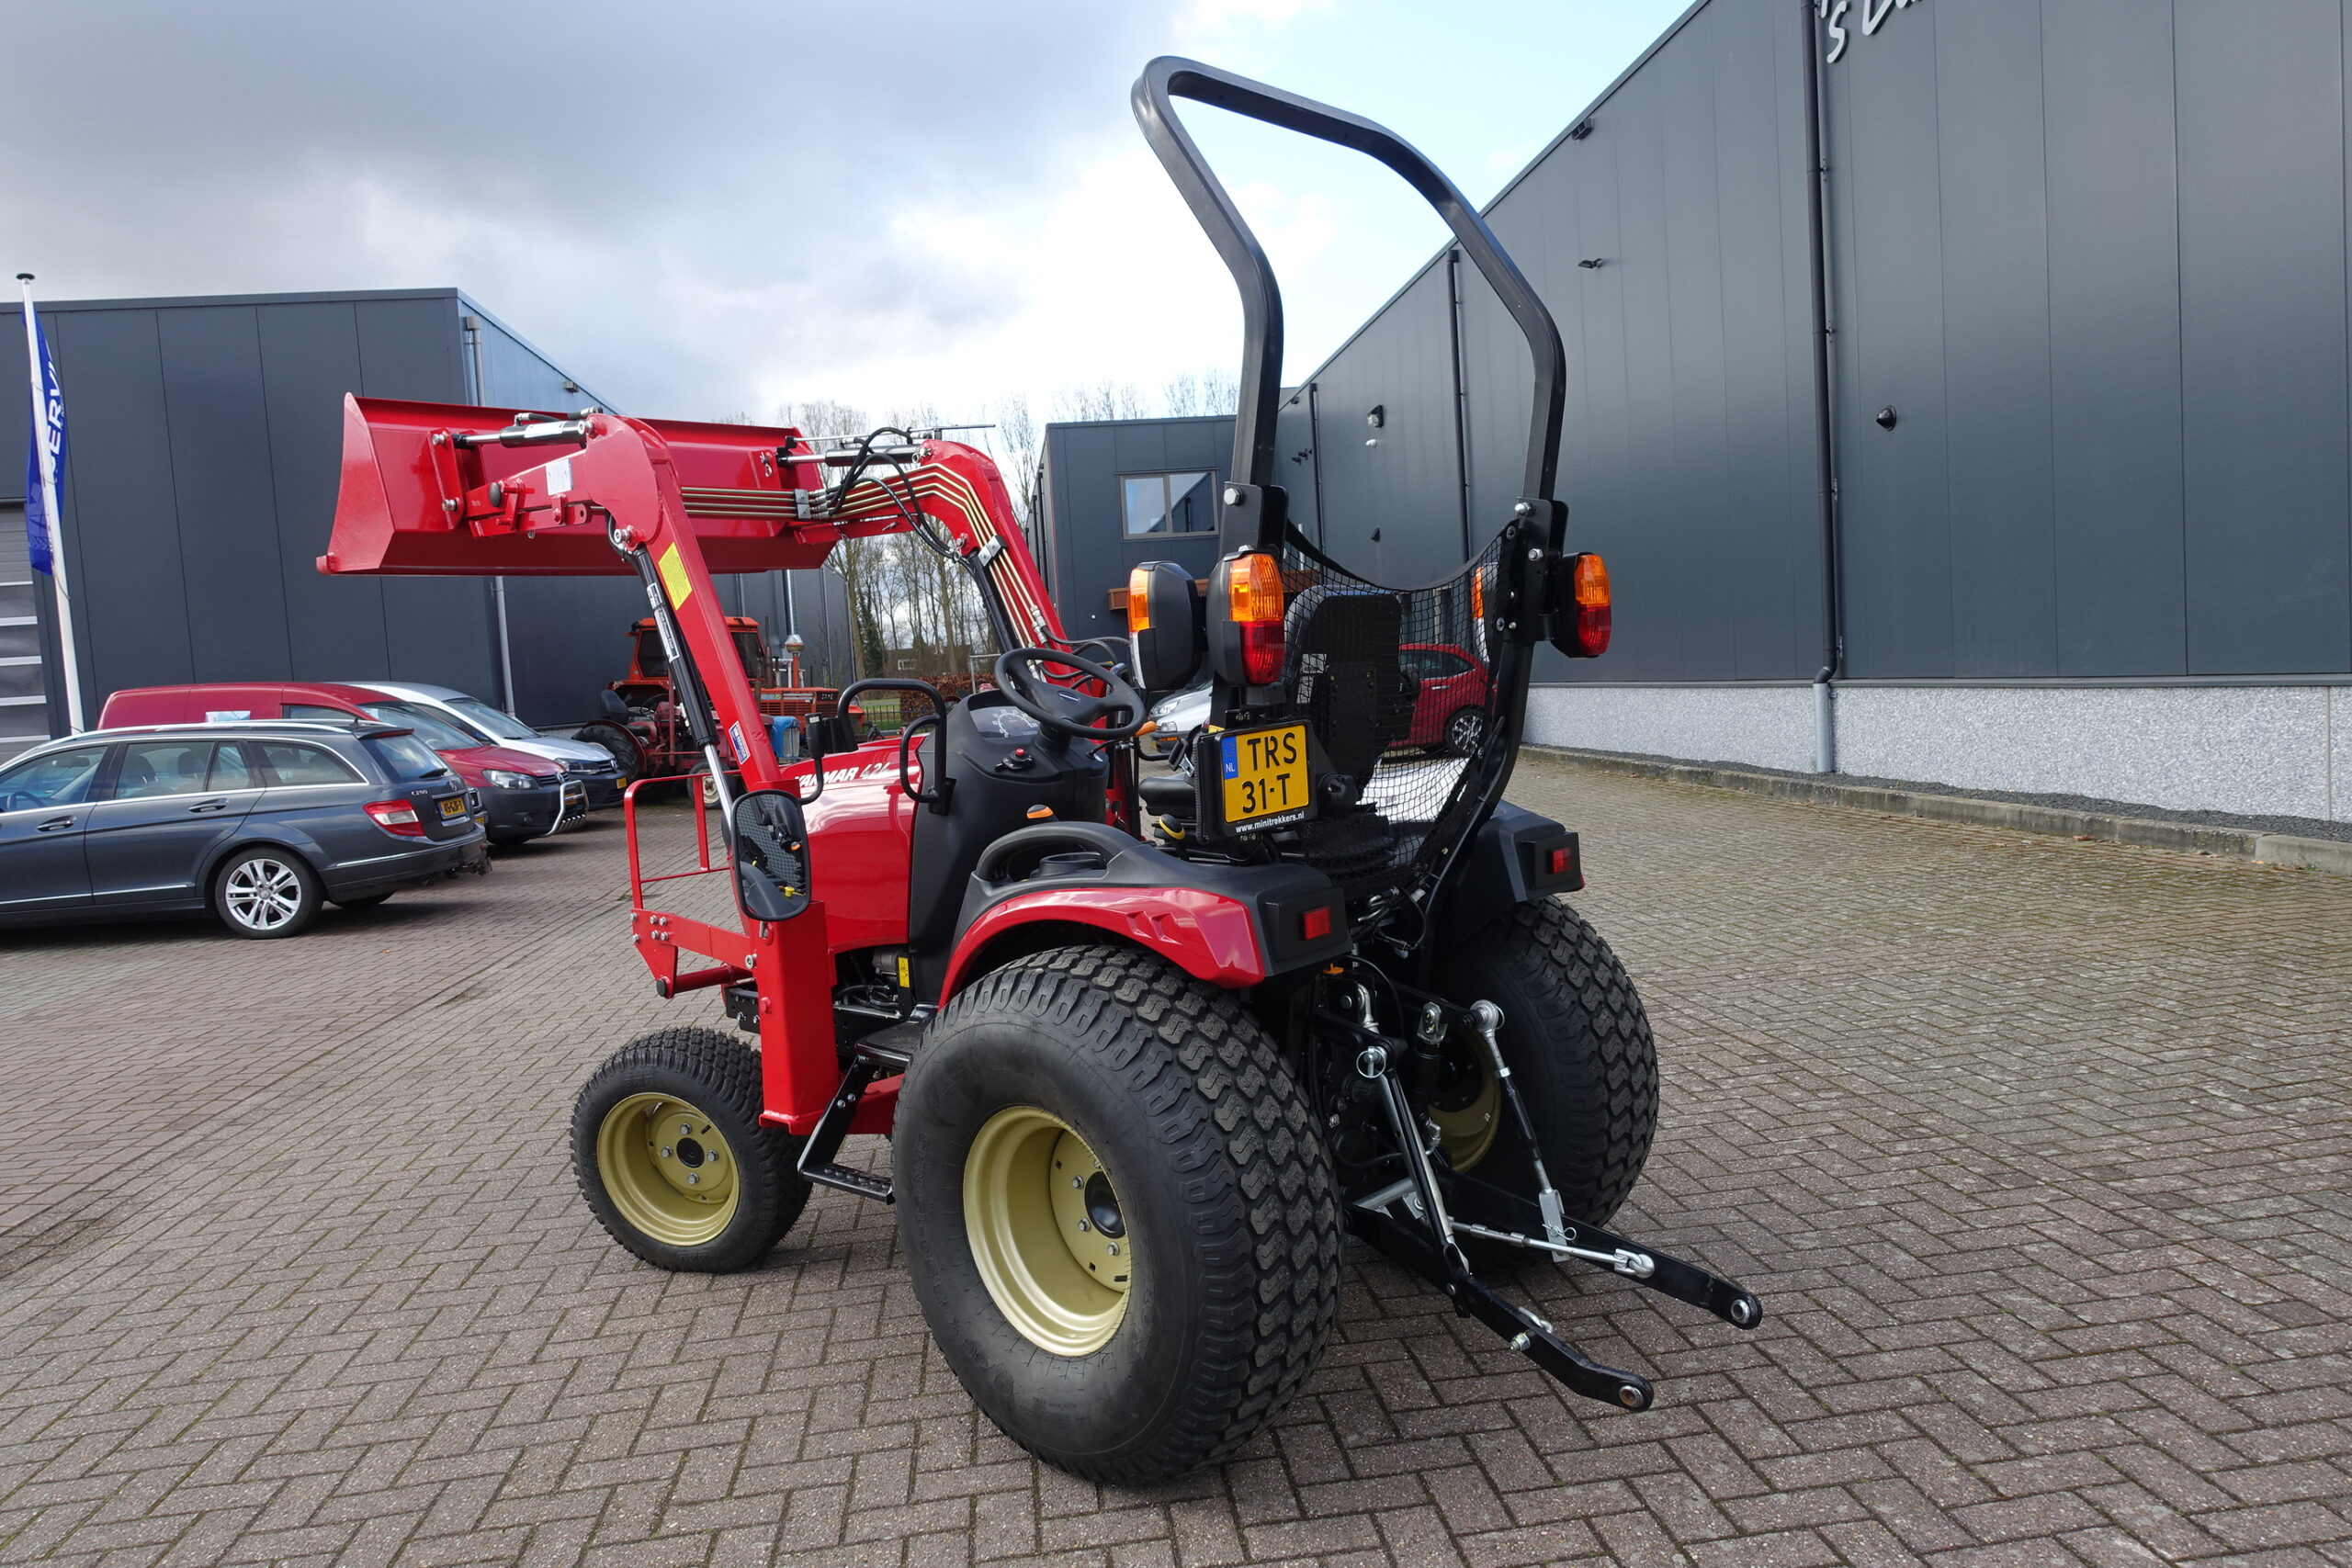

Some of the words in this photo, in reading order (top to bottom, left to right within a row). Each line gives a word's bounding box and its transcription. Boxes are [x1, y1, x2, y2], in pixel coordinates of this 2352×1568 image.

[1247, 732, 1297, 771] TRS
[859, 761, 892, 780] 424
[1225, 762, 1236, 773] NL
[1235, 810, 1305, 833] www.minitrekkers.nl
